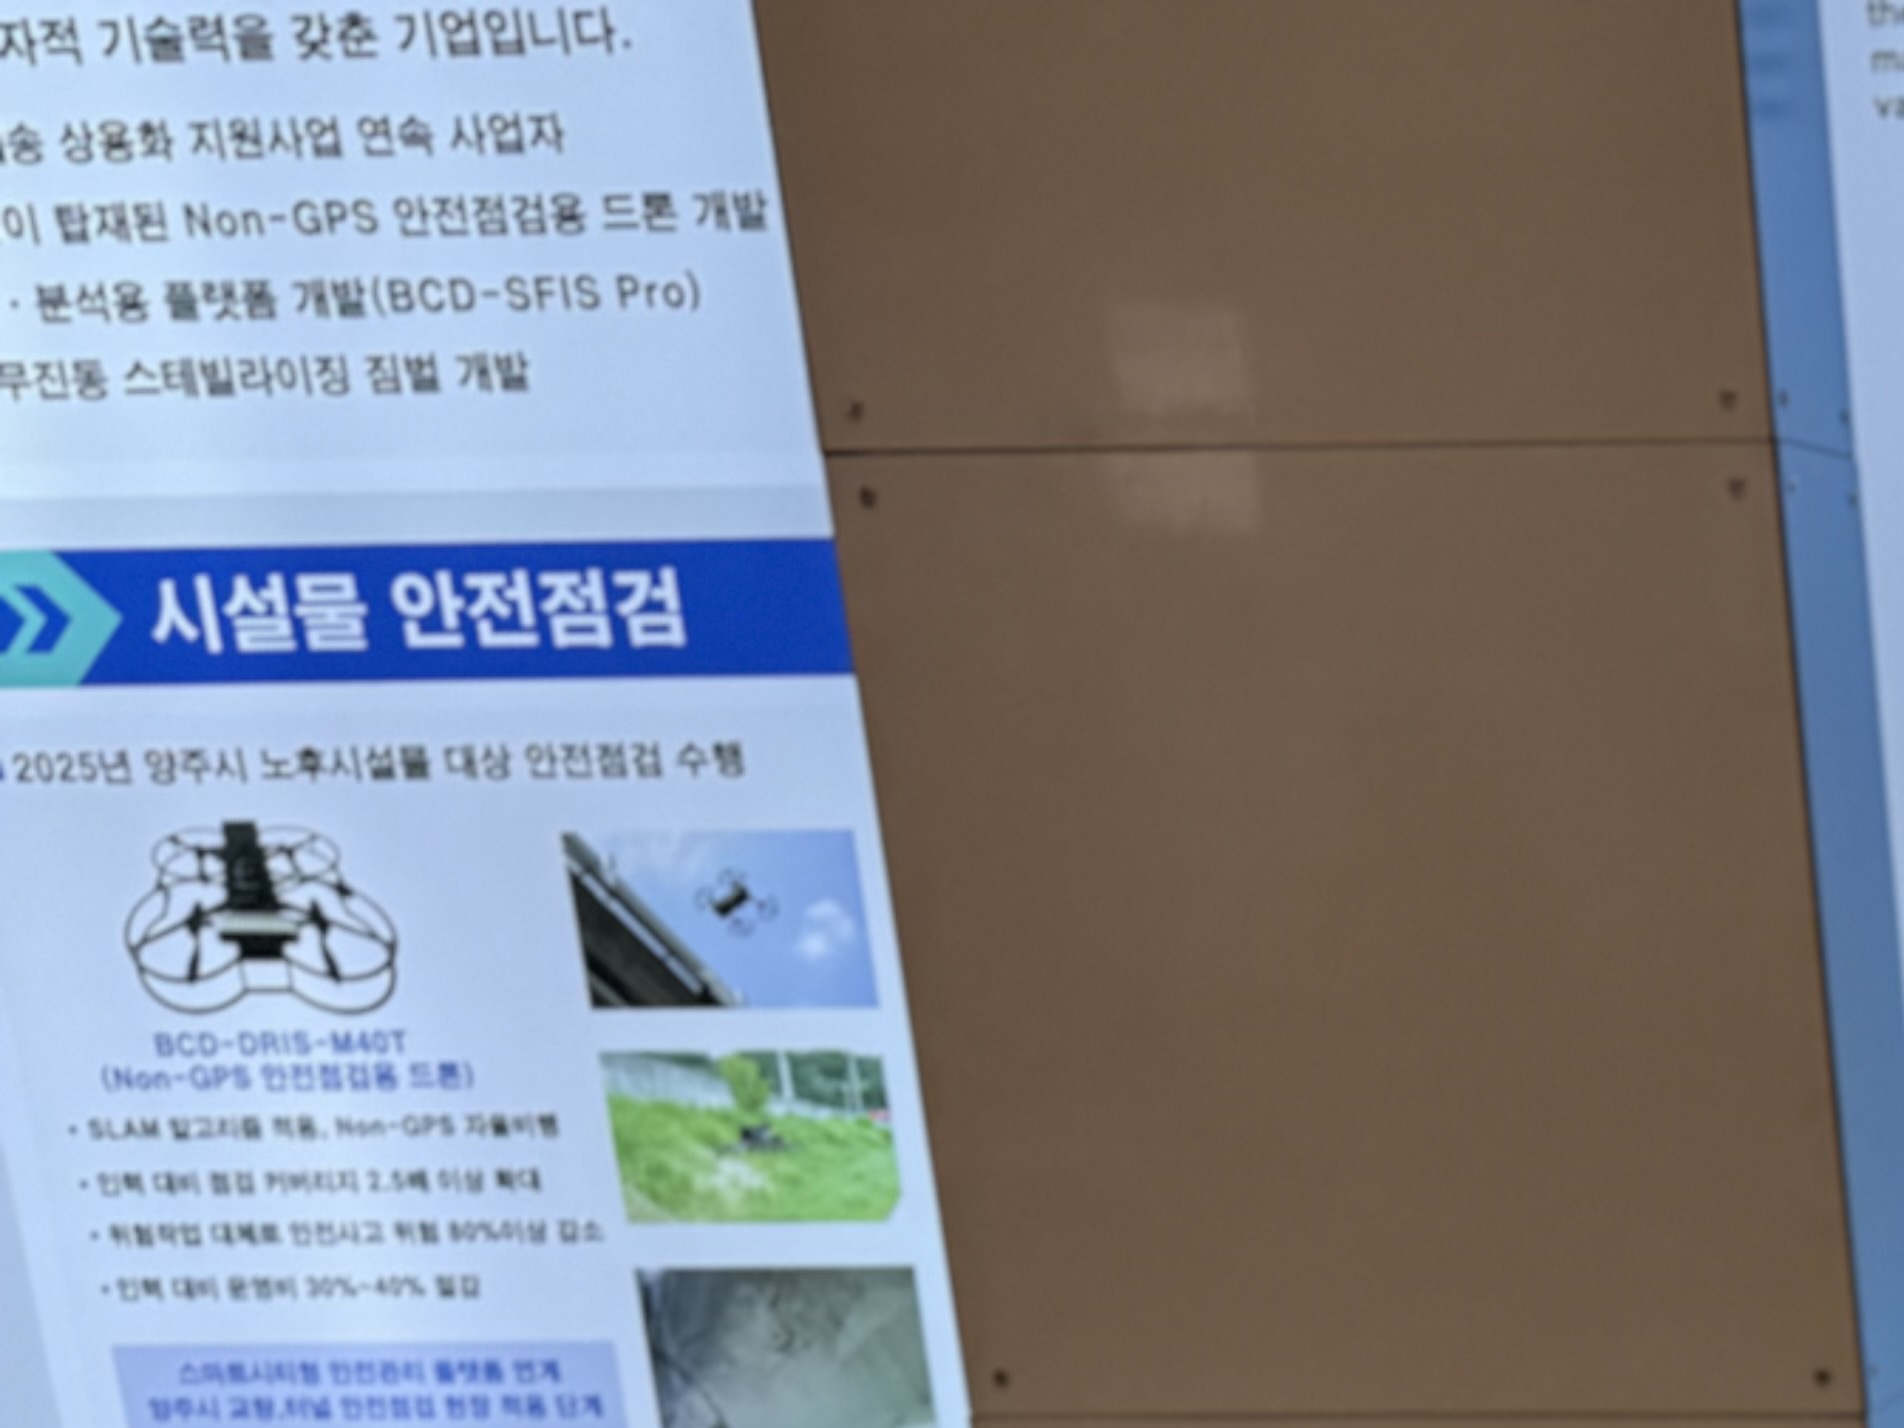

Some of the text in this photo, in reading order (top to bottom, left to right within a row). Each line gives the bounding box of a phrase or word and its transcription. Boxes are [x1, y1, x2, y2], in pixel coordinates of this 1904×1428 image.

[97, 13, 275, 64] 기술력을
[291, 10, 379, 61] 갖춘
[394, 7, 632, 58] 기업입니다.
[0, 112, 565, 166] 송 상용화 지원사업 연속 사업자
[52, 201, 169, 246] 탑재된
[182, 198, 380, 239] Non-GPS
[392, 192, 587, 238] 안전점검용
[602, 191, 678, 232] 드론
[692, 190, 768, 232] 개발
[35, 271, 701, 324] 분석용 플랫폼 개발(BCD-SFIS Pro)
[124, 355, 351, 398] 스테빌라이징
[365, 353, 442, 395] 짐벌
[455, 351, 530, 393] 개발
[151, 567, 686, 654] 시설물 안전점검
[12, 741, 746, 786] 2025년 양주시 노후시설물 대상 안전점검 수행
